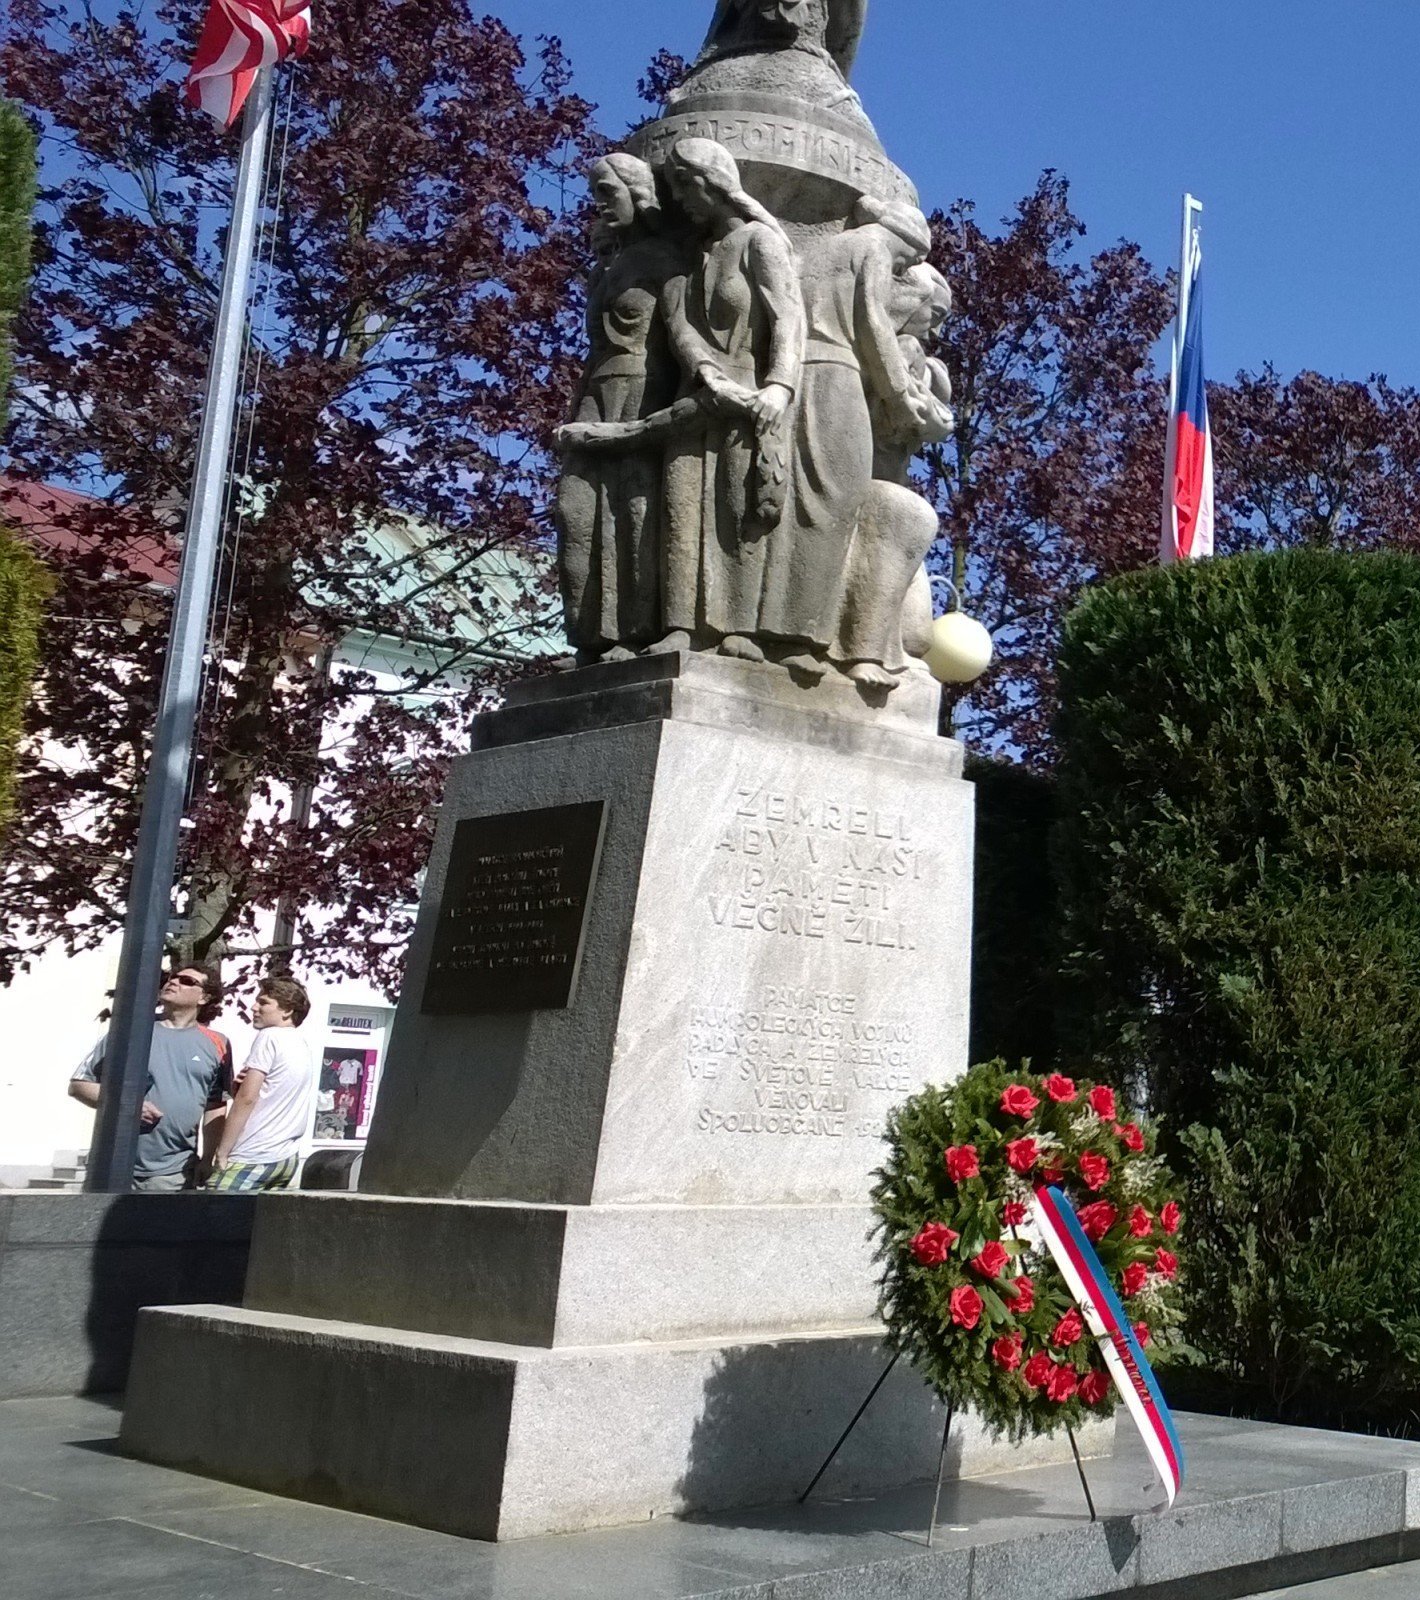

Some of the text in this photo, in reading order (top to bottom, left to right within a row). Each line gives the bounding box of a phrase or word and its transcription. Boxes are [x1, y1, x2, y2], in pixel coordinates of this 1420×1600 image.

[714, 825, 790, 863] ABY
[707, 893, 826, 940] VĚČNĚ
[780, 1043, 798, 1060] A
[685, 1057, 719, 1080] VE
